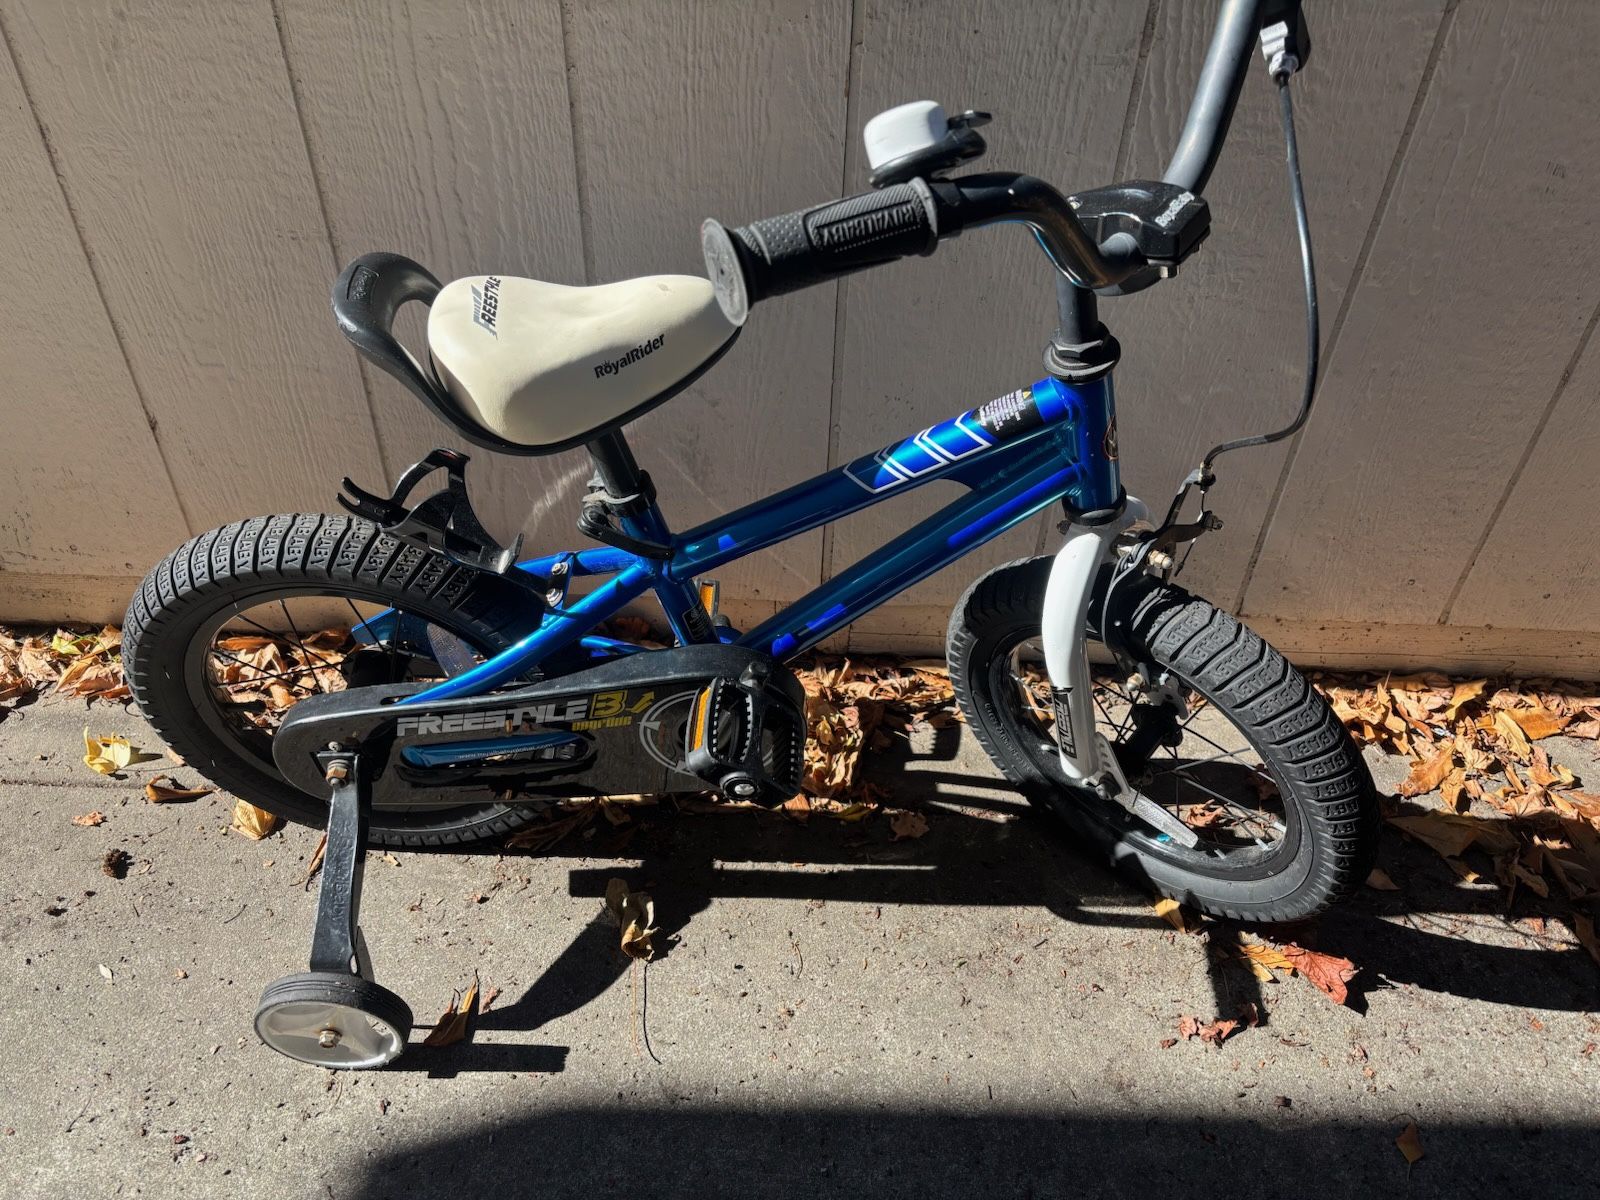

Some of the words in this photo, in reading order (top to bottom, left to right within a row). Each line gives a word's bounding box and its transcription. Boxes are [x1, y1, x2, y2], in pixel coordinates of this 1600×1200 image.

[473, 276, 502, 340] FREESTYLE
[593, 333, 666, 381] RoyalRider
[396, 698, 588, 737] FREESTYLE
